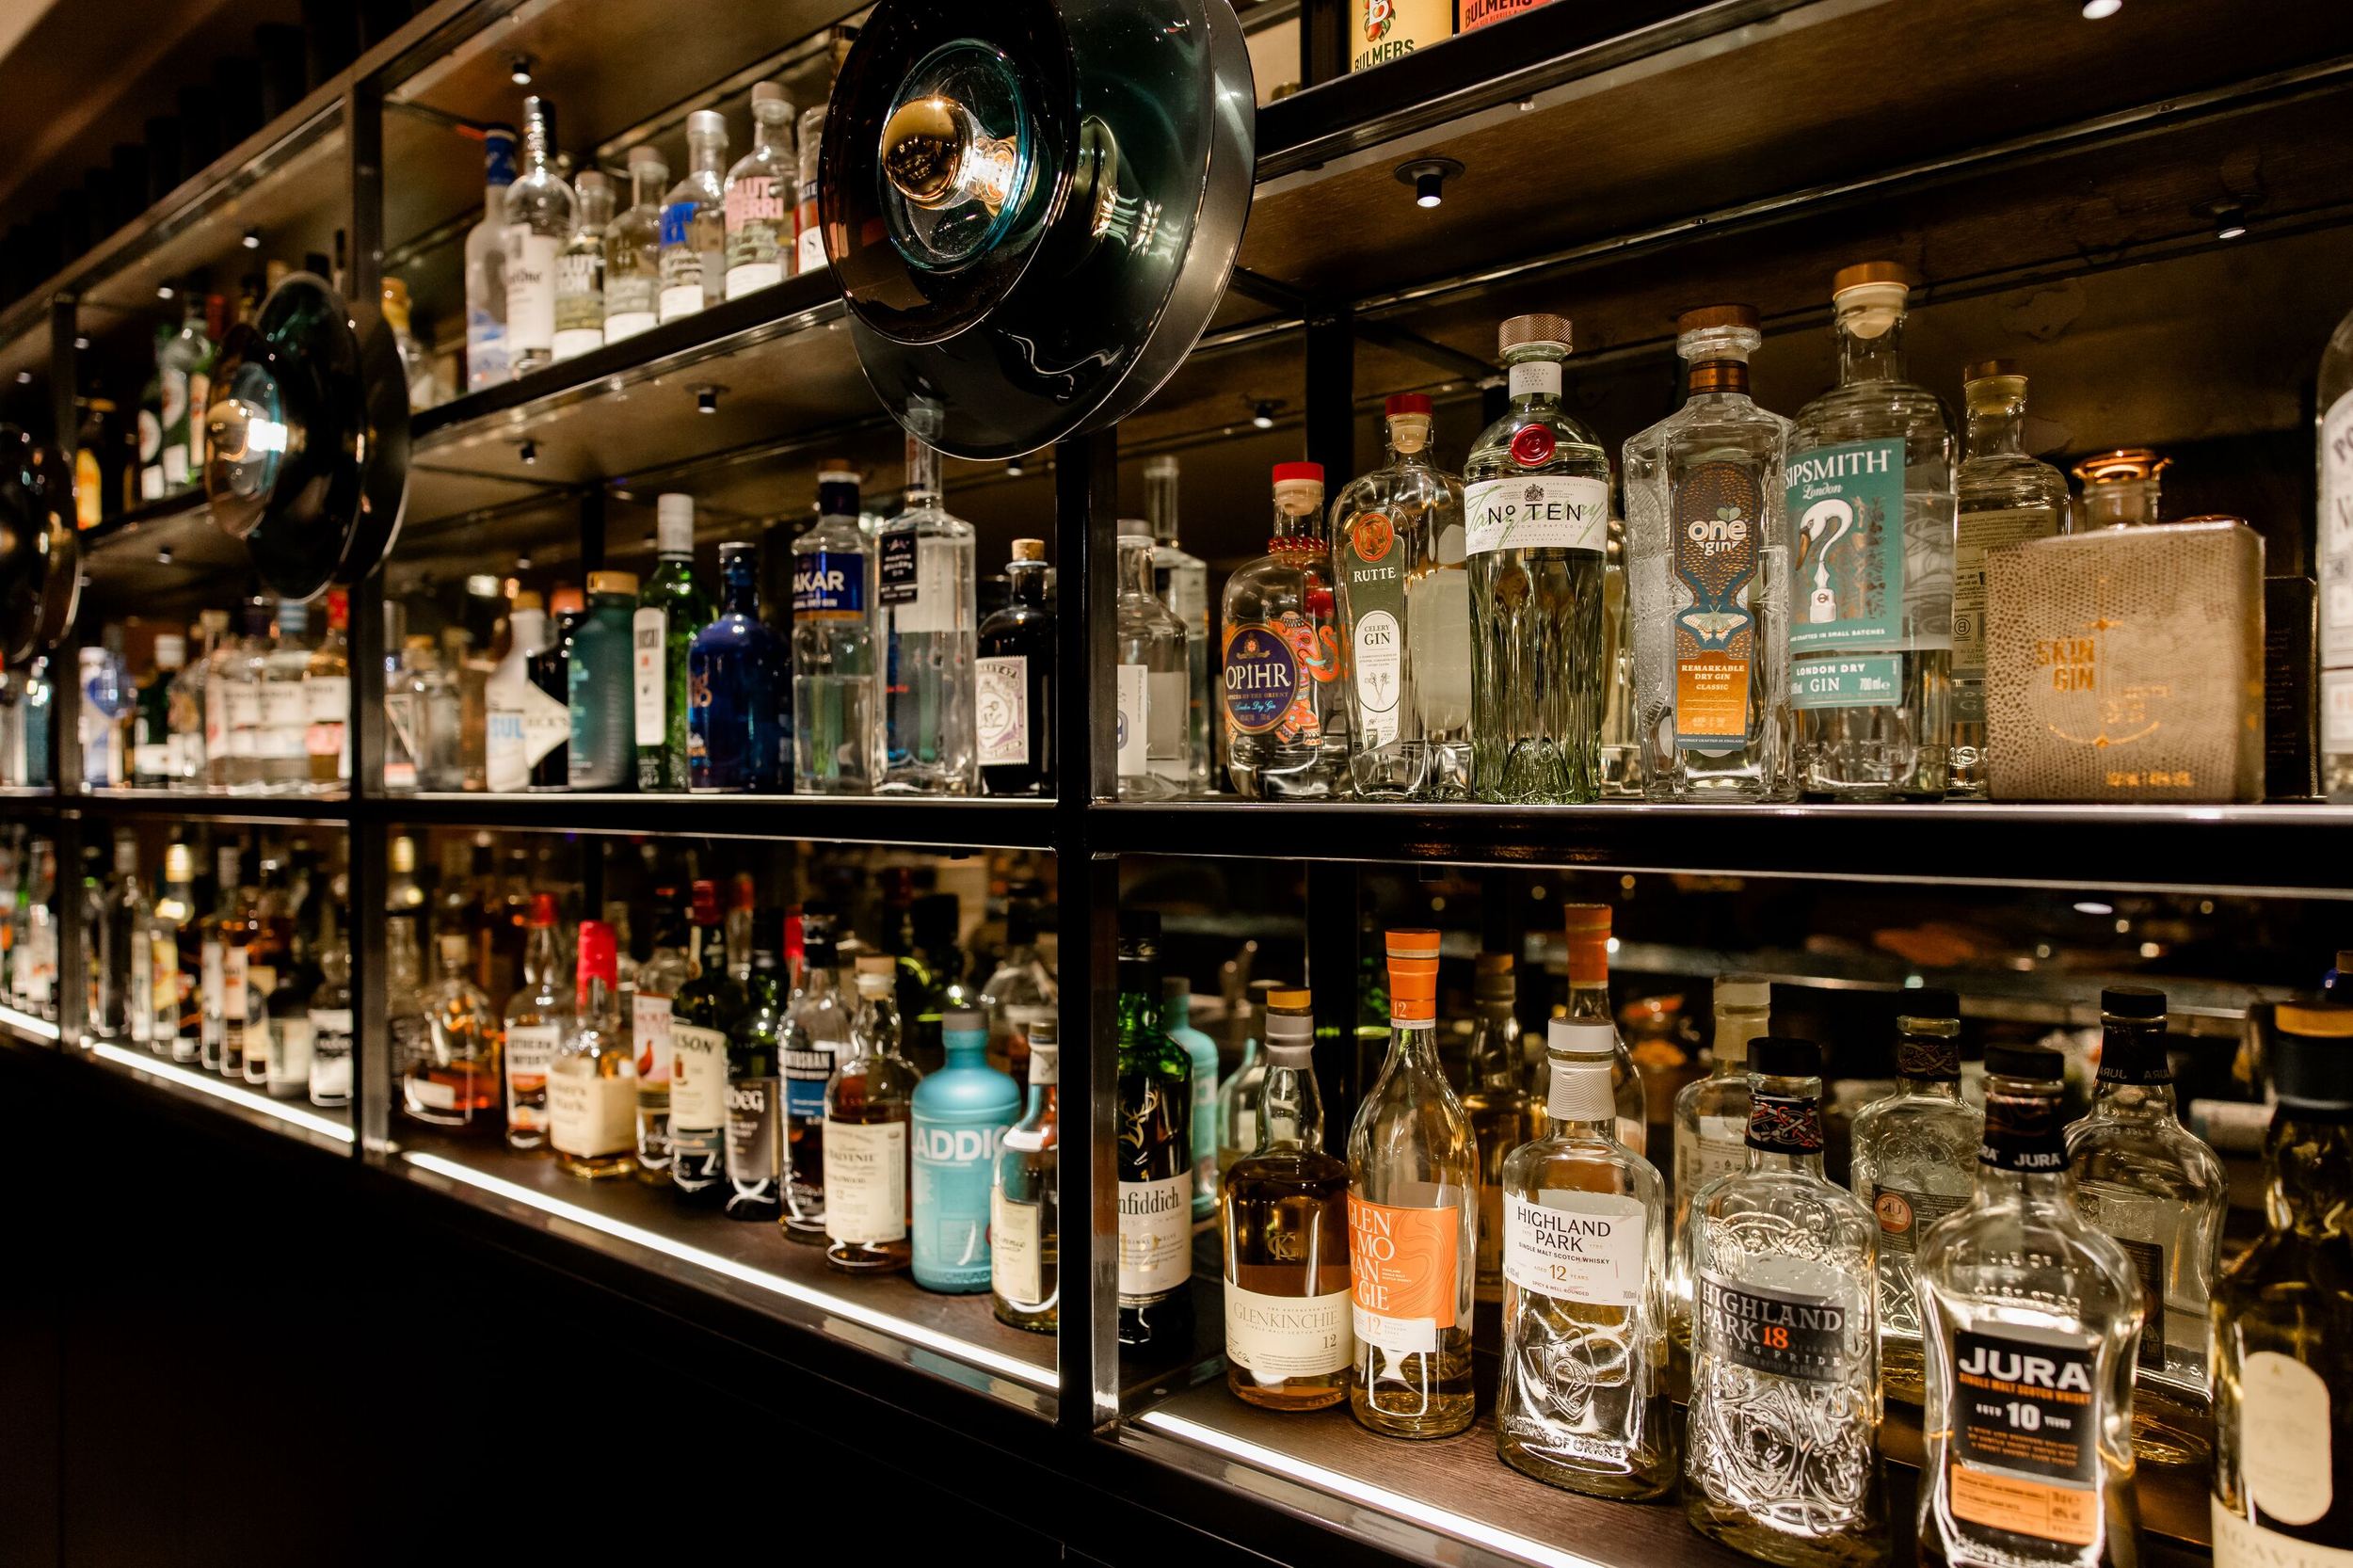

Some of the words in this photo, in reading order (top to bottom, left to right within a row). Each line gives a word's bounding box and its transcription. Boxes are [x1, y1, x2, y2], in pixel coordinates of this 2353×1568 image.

[1355, 39, 1415, 72] BULMERS
[1785, 449, 1890, 489] SIPSMITH
[1802, 482, 1844, 500] London
[1525, 503, 1582, 521] TEN
[1688, 520, 1748, 541] one
[1705, 541, 1732, 556] gin
[1353, 567, 1397, 583] RUTTE
[1364, 624, 1390, 632] CELERY
[1364, 632, 1391, 647] GIN
[1852, 628, 1885, 636] BATCHES
[2036, 636, 2096, 665] SKIN
[1225, 663, 1292, 691] OPIHR
[1681, 664, 1745, 673] REMARKABLE
[1796, 664, 1836, 677] LONDON
[1840, 663, 1865, 674] DRY
[2053, 666, 2095, 693] GIN
[1810, 677, 1840, 693] GIN
[2013, 1152, 2061, 1168] JURA
[1348, 1200, 1392, 1238] GLEN
[1517, 1206, 1611, 1238] HIGHLAND
[1356, 1230, 1396, 1261] MO
[1518, 1241, 1536, 1253] SINGLE
[1537, 1248, 1552, 1256] MALT
[1554, 1252, 1581, 1262] SCOTCH
[1582, 1256, 1610, 1265] WHISKY
[1536, 1229, 1583, 1253] PARK
[1350, 1249, 1380, 1284] RAN
[1549, 1264, 1567, 1282] 12
[1358, 1279, 1390, 1311] GIE
[1702, 1280, 1843, 1332] HIGHLAND
[1234, 1302, 1340, 1329] GLENKINCHIE
[1366, 1316, 1382, 1335] 12
[1702, 1302, 1760, 1344] PARK
[1763, 1325, 1789, 1350] 18
[1323, 1334, 1337, 1349] 12
[1703, 1326, 1762, 1355] VIKING
[1774, 1350, 1842, 1368] PRIDE
[1958, 1346, 2092, 1392] JURA
[2006, 1401, 2041, 1431] 10
